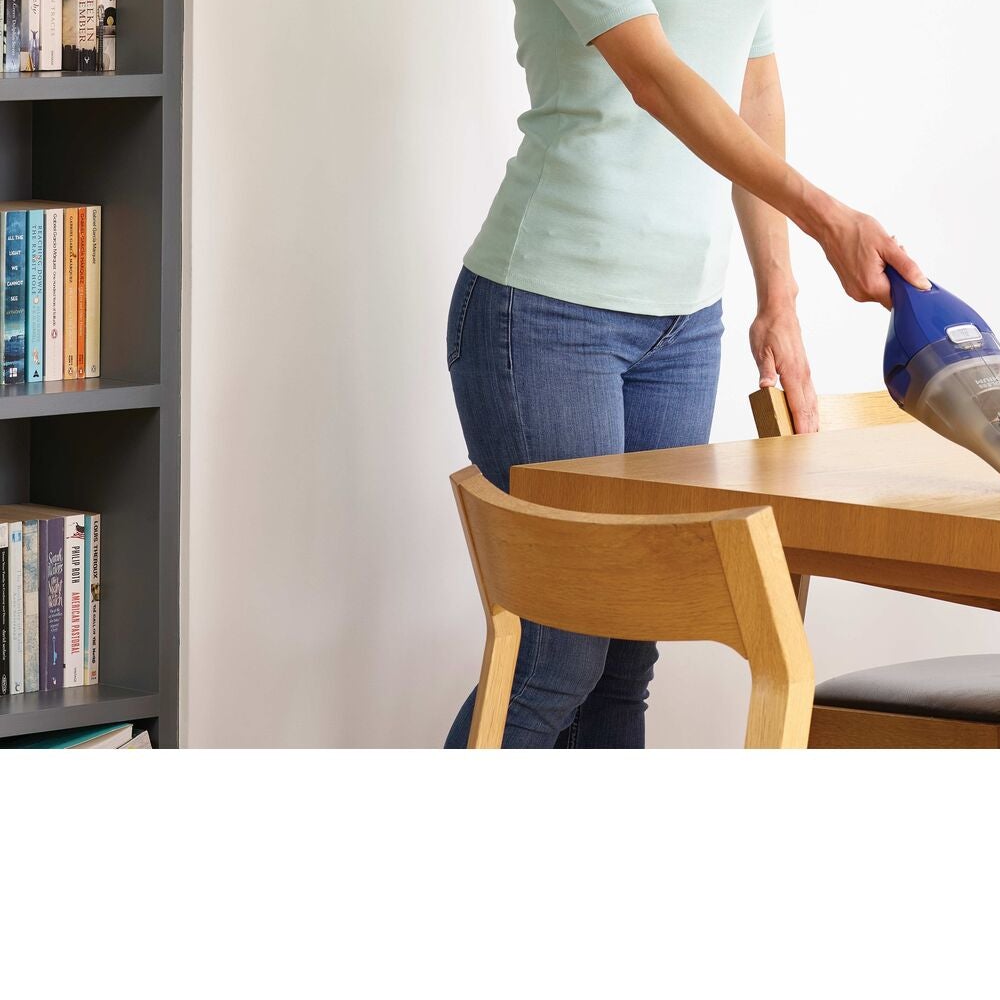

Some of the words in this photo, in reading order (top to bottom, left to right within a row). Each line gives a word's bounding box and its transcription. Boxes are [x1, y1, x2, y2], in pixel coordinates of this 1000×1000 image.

[86, 27, 94, 42] IN
[72, 545, 81, 567] PHILIP
[72, 568, 81, 584] ROTH
[72, 592, 81, 623] AMERICAN
[72, 624, 81, 655] PASTORAL
